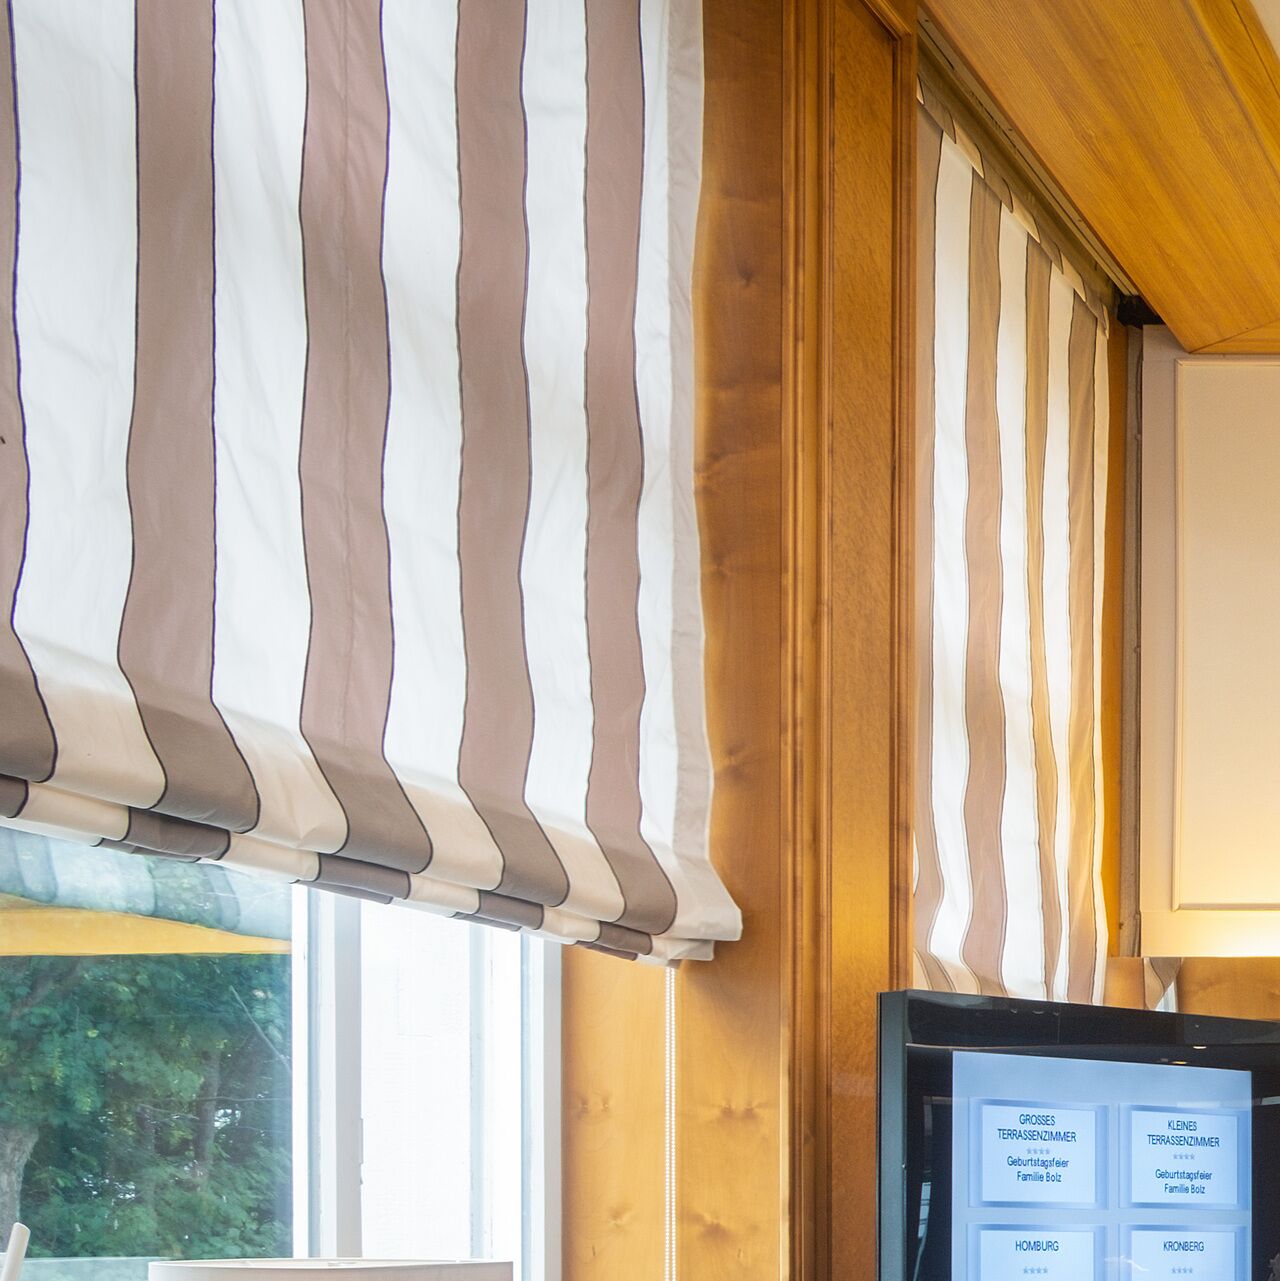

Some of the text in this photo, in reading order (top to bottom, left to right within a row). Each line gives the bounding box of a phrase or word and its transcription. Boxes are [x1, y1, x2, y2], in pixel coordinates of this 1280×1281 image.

[1019, 1113, 1056, 1126] GROSSES
[1167, 1120, 1197, 1131] KLEINES
[997, 1128, 1077, 1142] TERRASSENZIMMER
[1147, 1134, 1220, 1147] TERRASSENZIMMER
[1007, 1155, 1069, 1170] Geburtstagsfeier
[1017, 1171, 1062, 1182] Familie Bolz
[1155, 1169, 1212, 1182] Geburtstagsfeier
[1164, 1183, 1206, 1194] Familie Bolz
[1015, 1240, 1059, 1251] HOMBURG
[1163, 1241, 1204, 1252] KRONBERG
